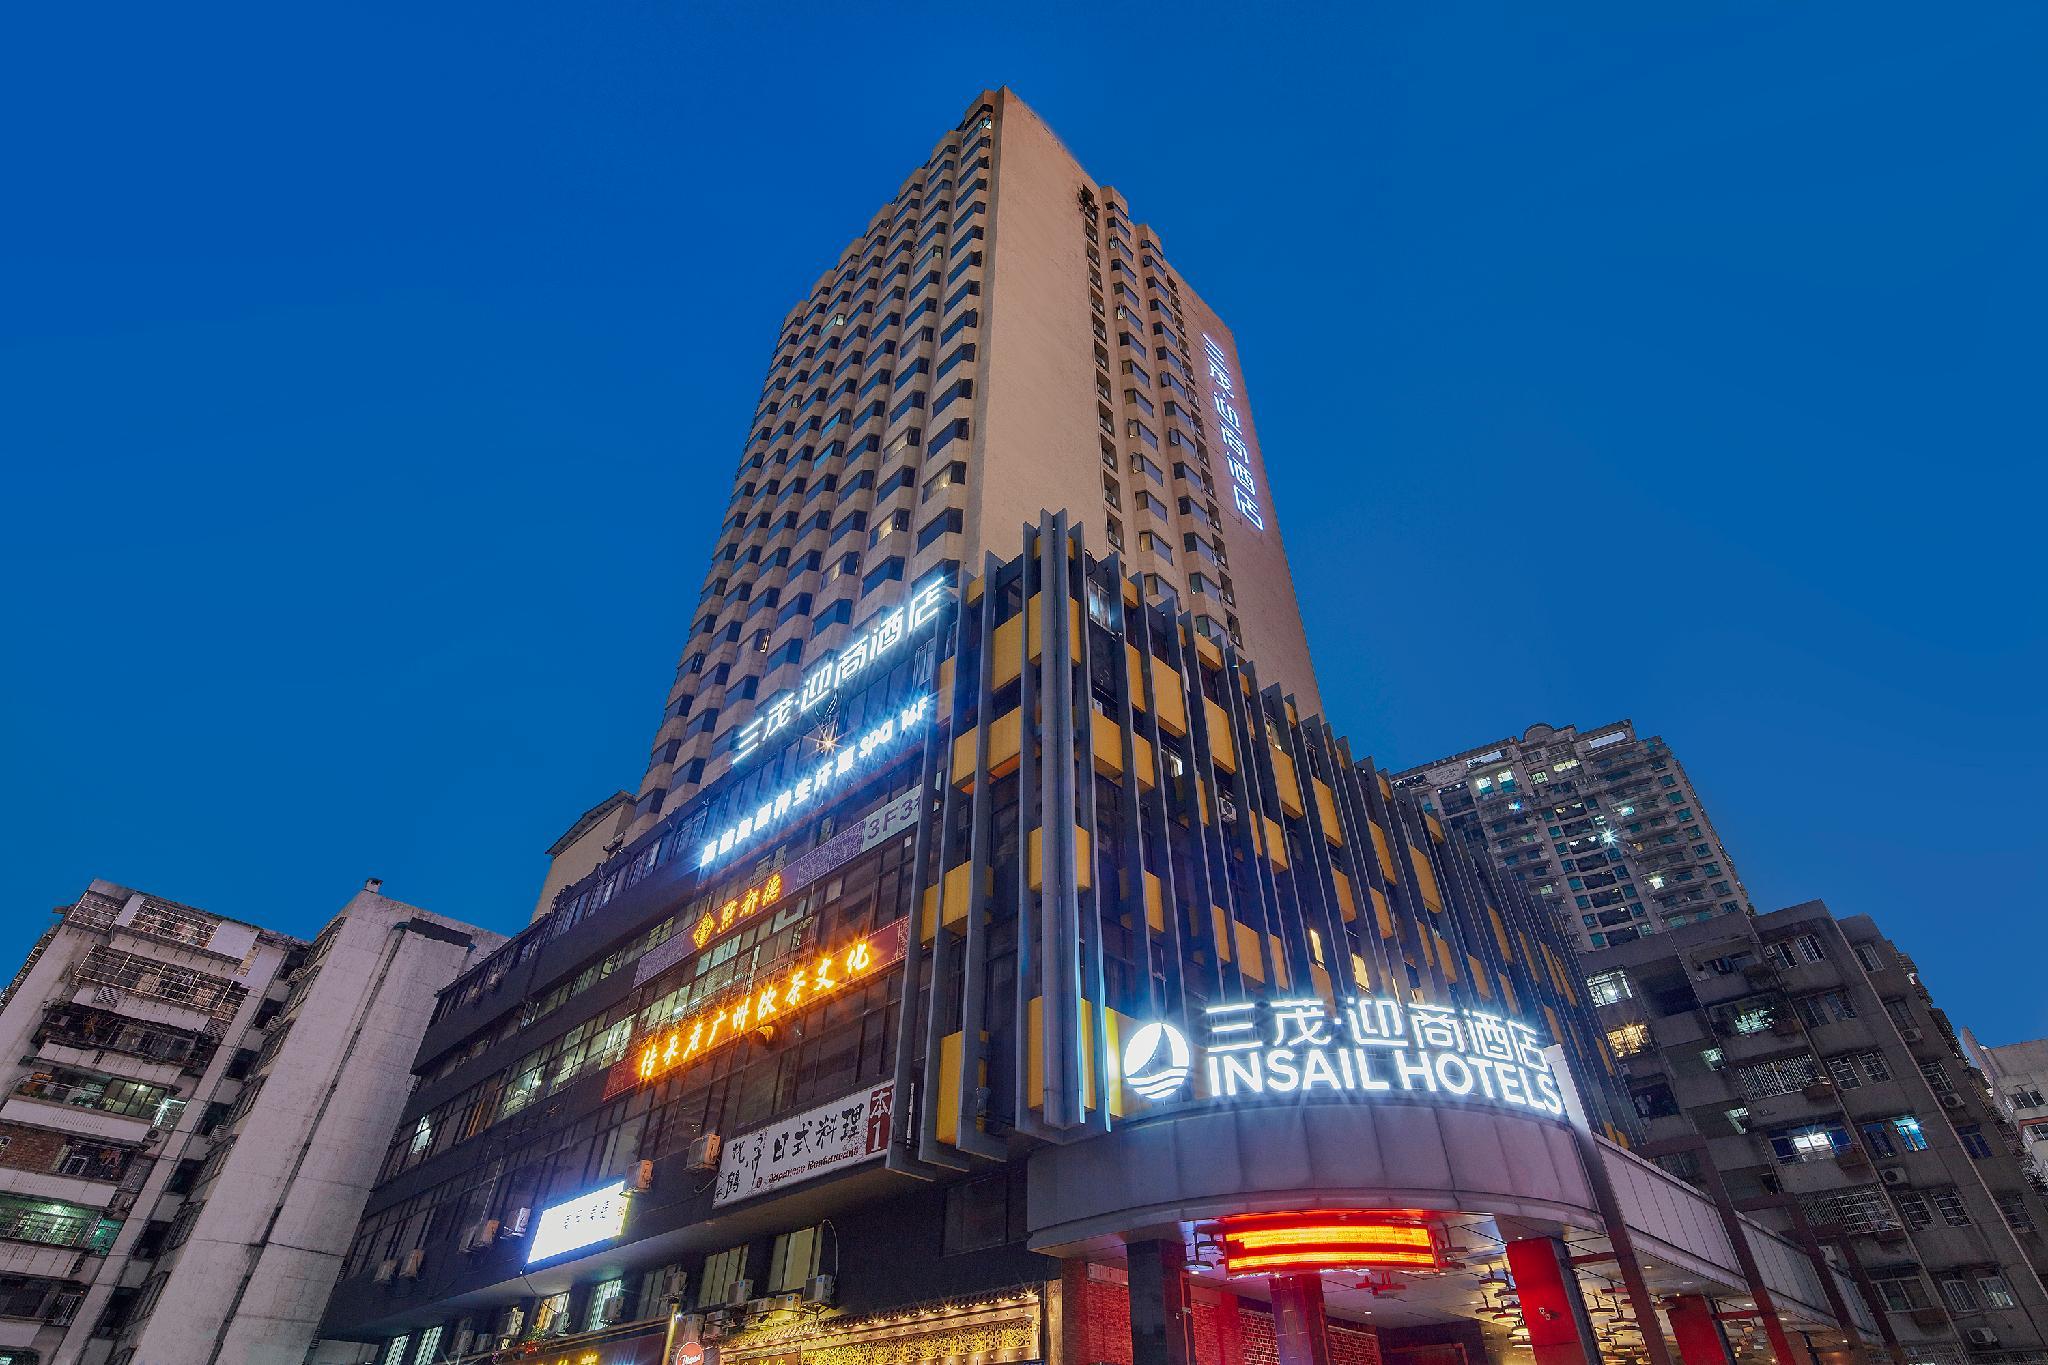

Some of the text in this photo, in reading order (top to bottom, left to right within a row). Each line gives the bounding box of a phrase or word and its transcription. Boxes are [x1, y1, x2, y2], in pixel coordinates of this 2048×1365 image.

[1207, 1048, 1563, 1115] INSAIL HOTELS
[772, 1103, 865, 1164] 日式料理
